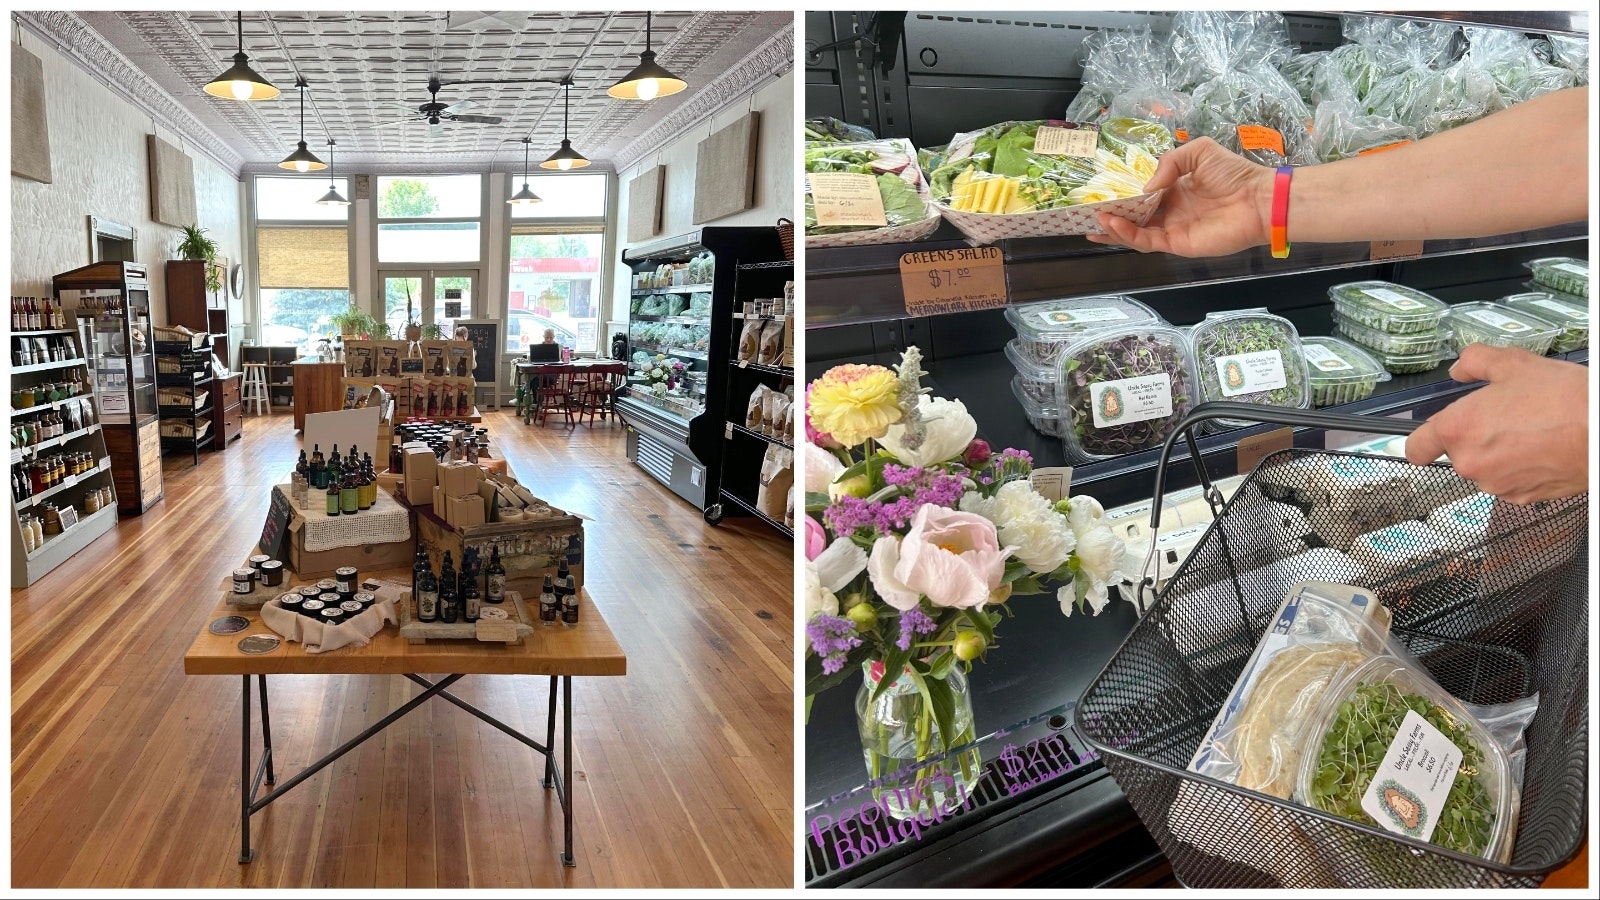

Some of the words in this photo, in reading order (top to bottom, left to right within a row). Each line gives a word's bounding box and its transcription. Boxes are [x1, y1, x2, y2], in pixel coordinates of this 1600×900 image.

[903, 249, 954, 265] GREENS
[957, 247, 998, 260] SALAD
[909, 301, 967, 316] MEADOWLARK
[969, 298, 1004, 311] KITCHEN
[1394, 753, 1407, 771] Uncle
[1402, 737, 1415, 756] Sassy
[1409, 723, 1422, 740] Farms
[1009, 762, 1074, 798] Barbara
[810, 768, 954, 848] Peonies
